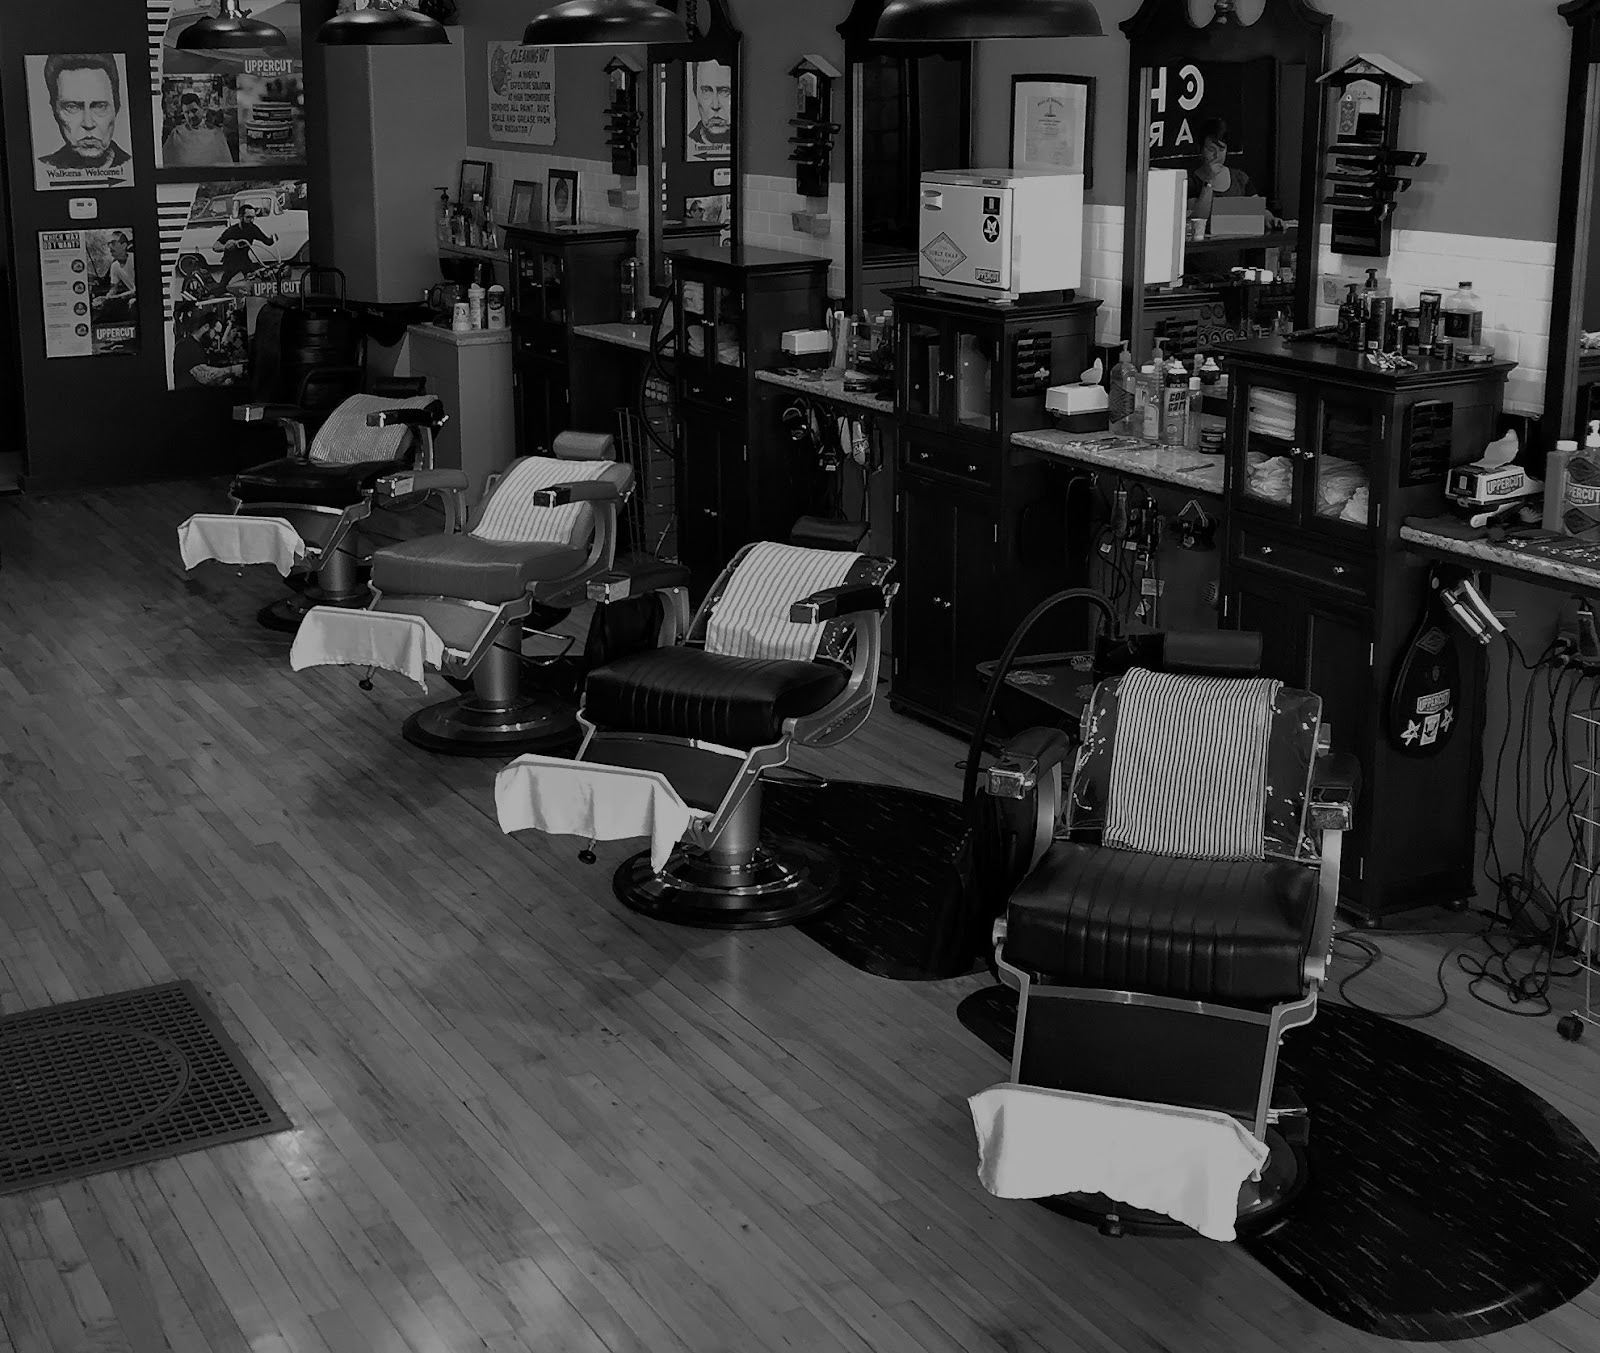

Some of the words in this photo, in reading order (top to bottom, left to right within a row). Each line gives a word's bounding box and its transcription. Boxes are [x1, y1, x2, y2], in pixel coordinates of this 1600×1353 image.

[244, 59, 293, 74] UPPERCUT
[510, 81, 531, 90] EFFECTIVE
[532, 81, 551, 90] SOLUTION
[511, 104, 519, 112] ALL
[491, 113, 505, 123] SCALE
[506, 115, 516, 123] AND
[517, 115, 536, 124] GREASE
[537, 115, 551, 124] FROM
[46, 169, 82, 179] Walkens
[84, 166, 124, 177] Welcome!
[254, 281, 301, 296] UPPECUT
[96, 327, 136, 340] UPPERCUT
[1487, 474, 1523, 494] UPPERCUT
